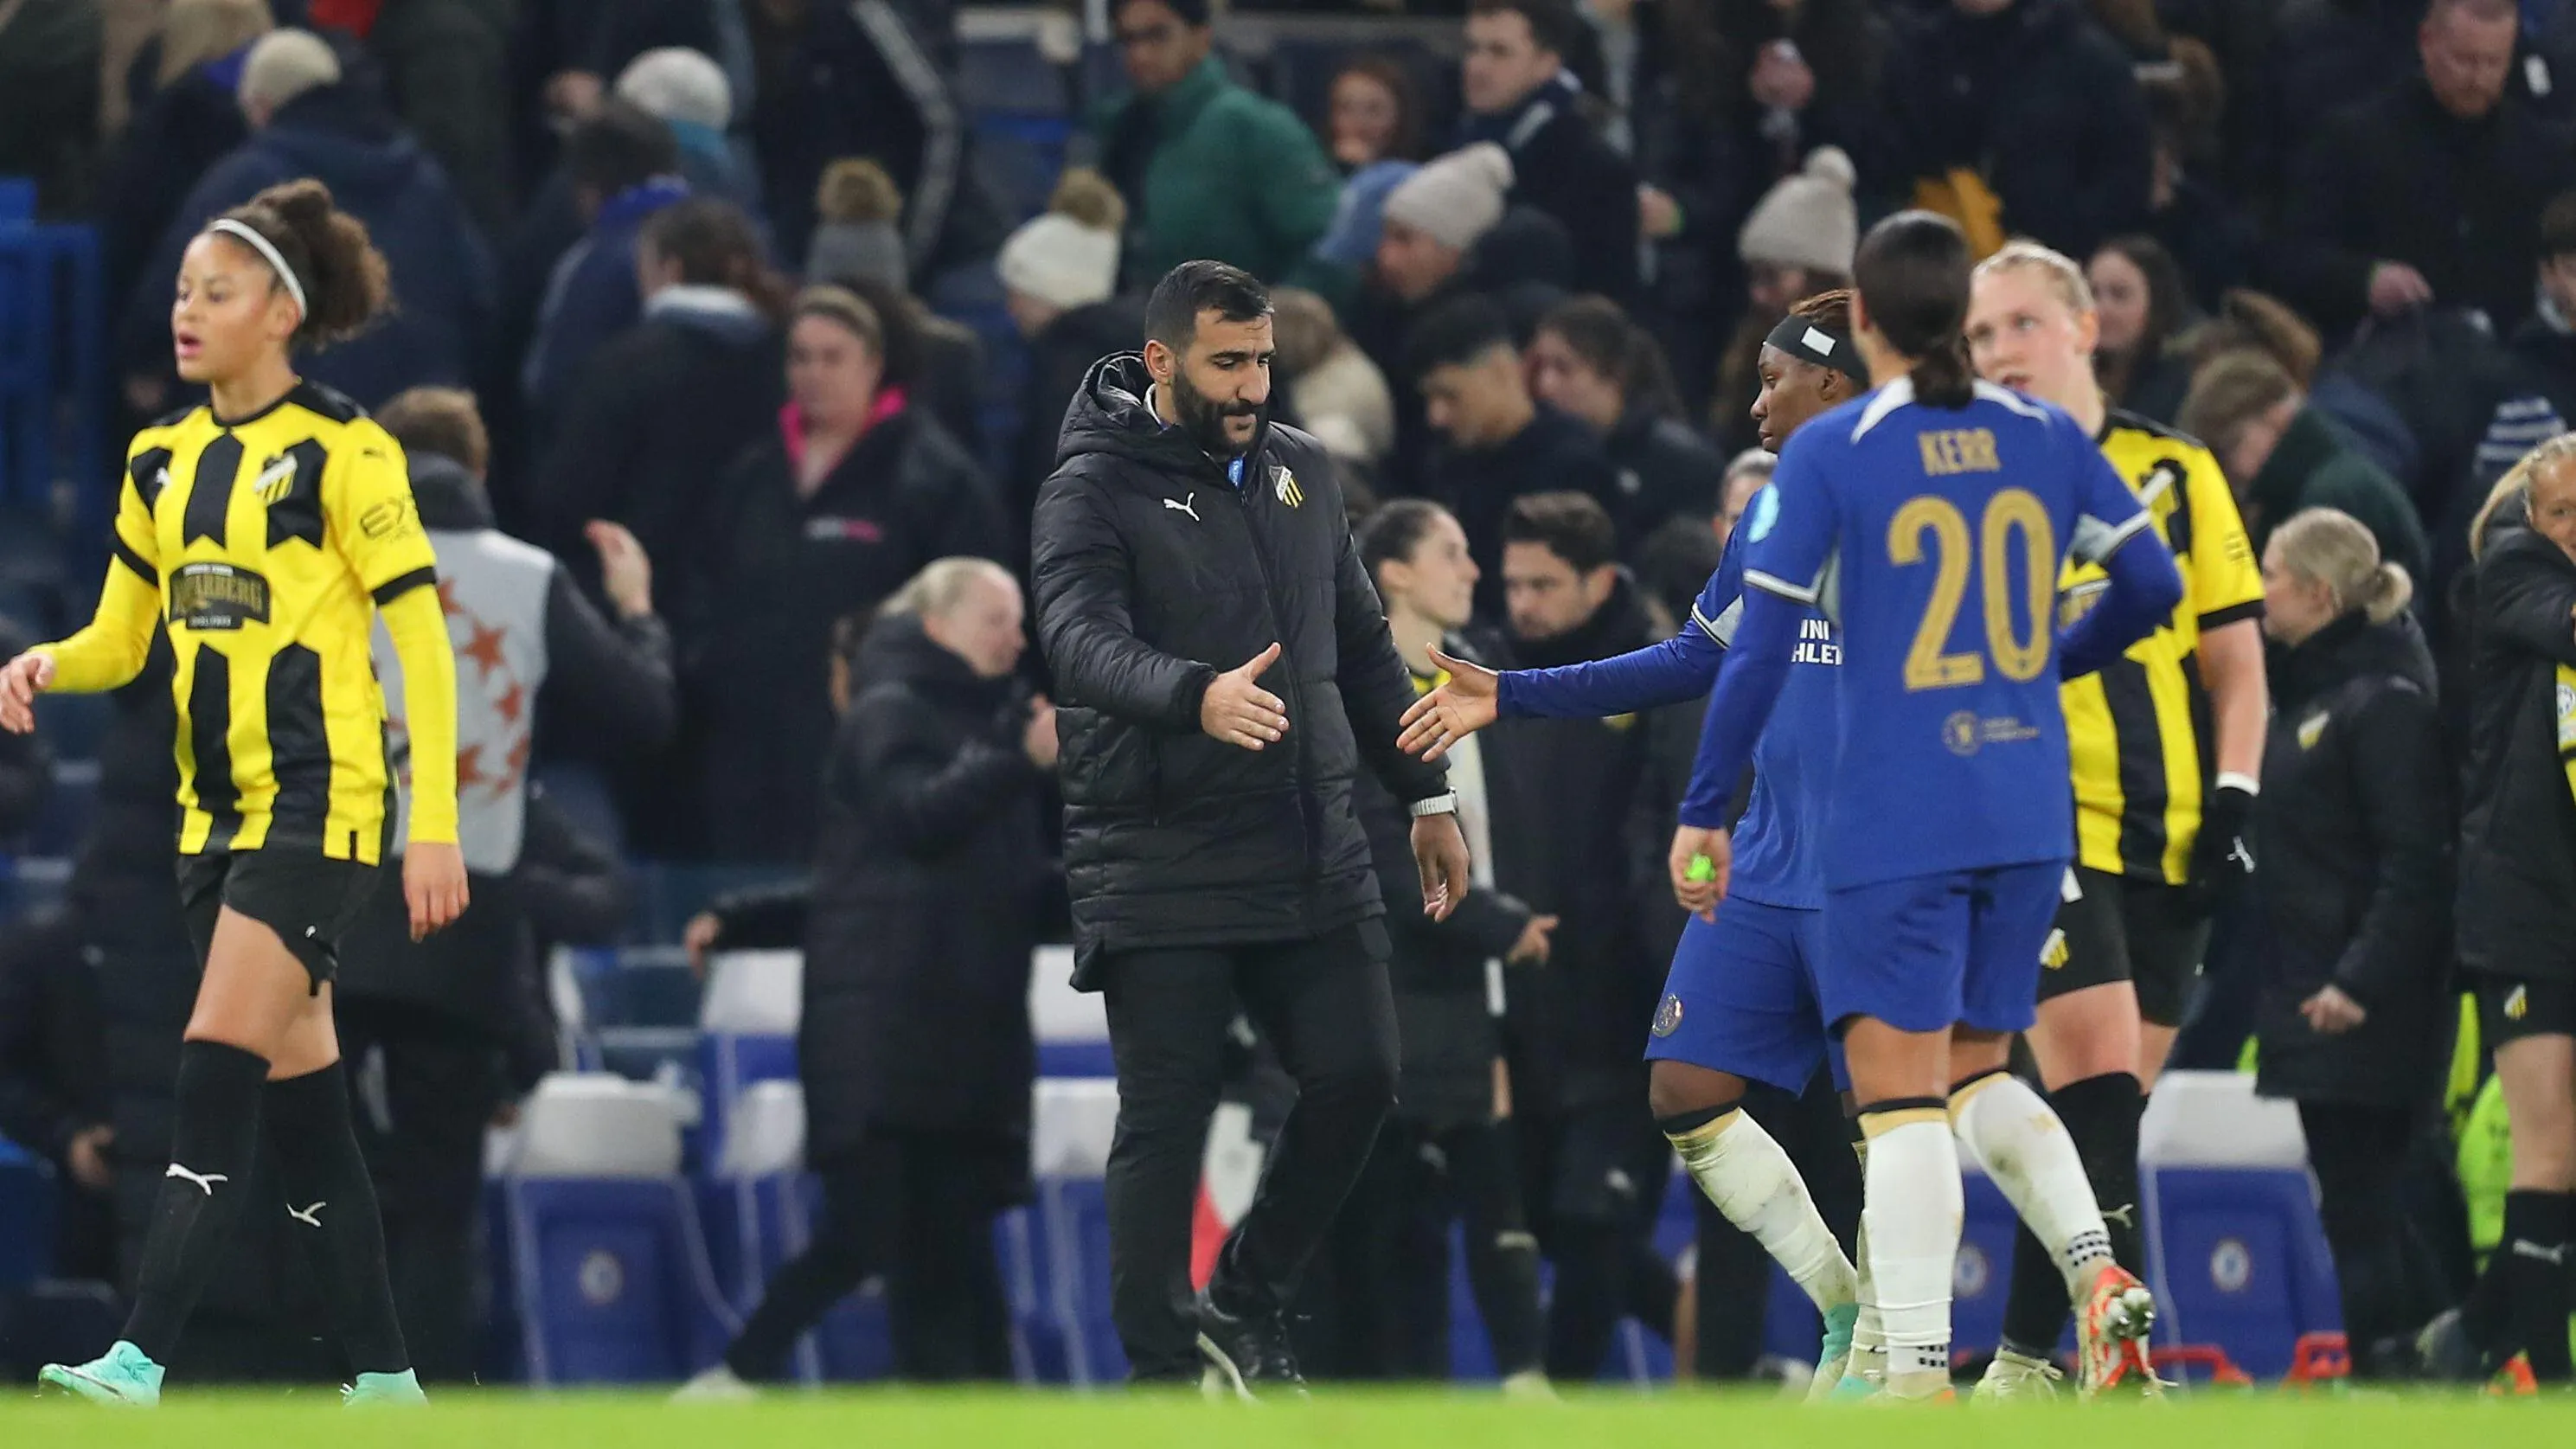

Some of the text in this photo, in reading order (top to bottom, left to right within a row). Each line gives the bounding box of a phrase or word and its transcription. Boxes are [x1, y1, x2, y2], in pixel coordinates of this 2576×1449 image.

[1918, 428, 2002, 475] KERR
[1887, 488, 2056, 690] 20
[1800, 619, 1829, 640] INI
